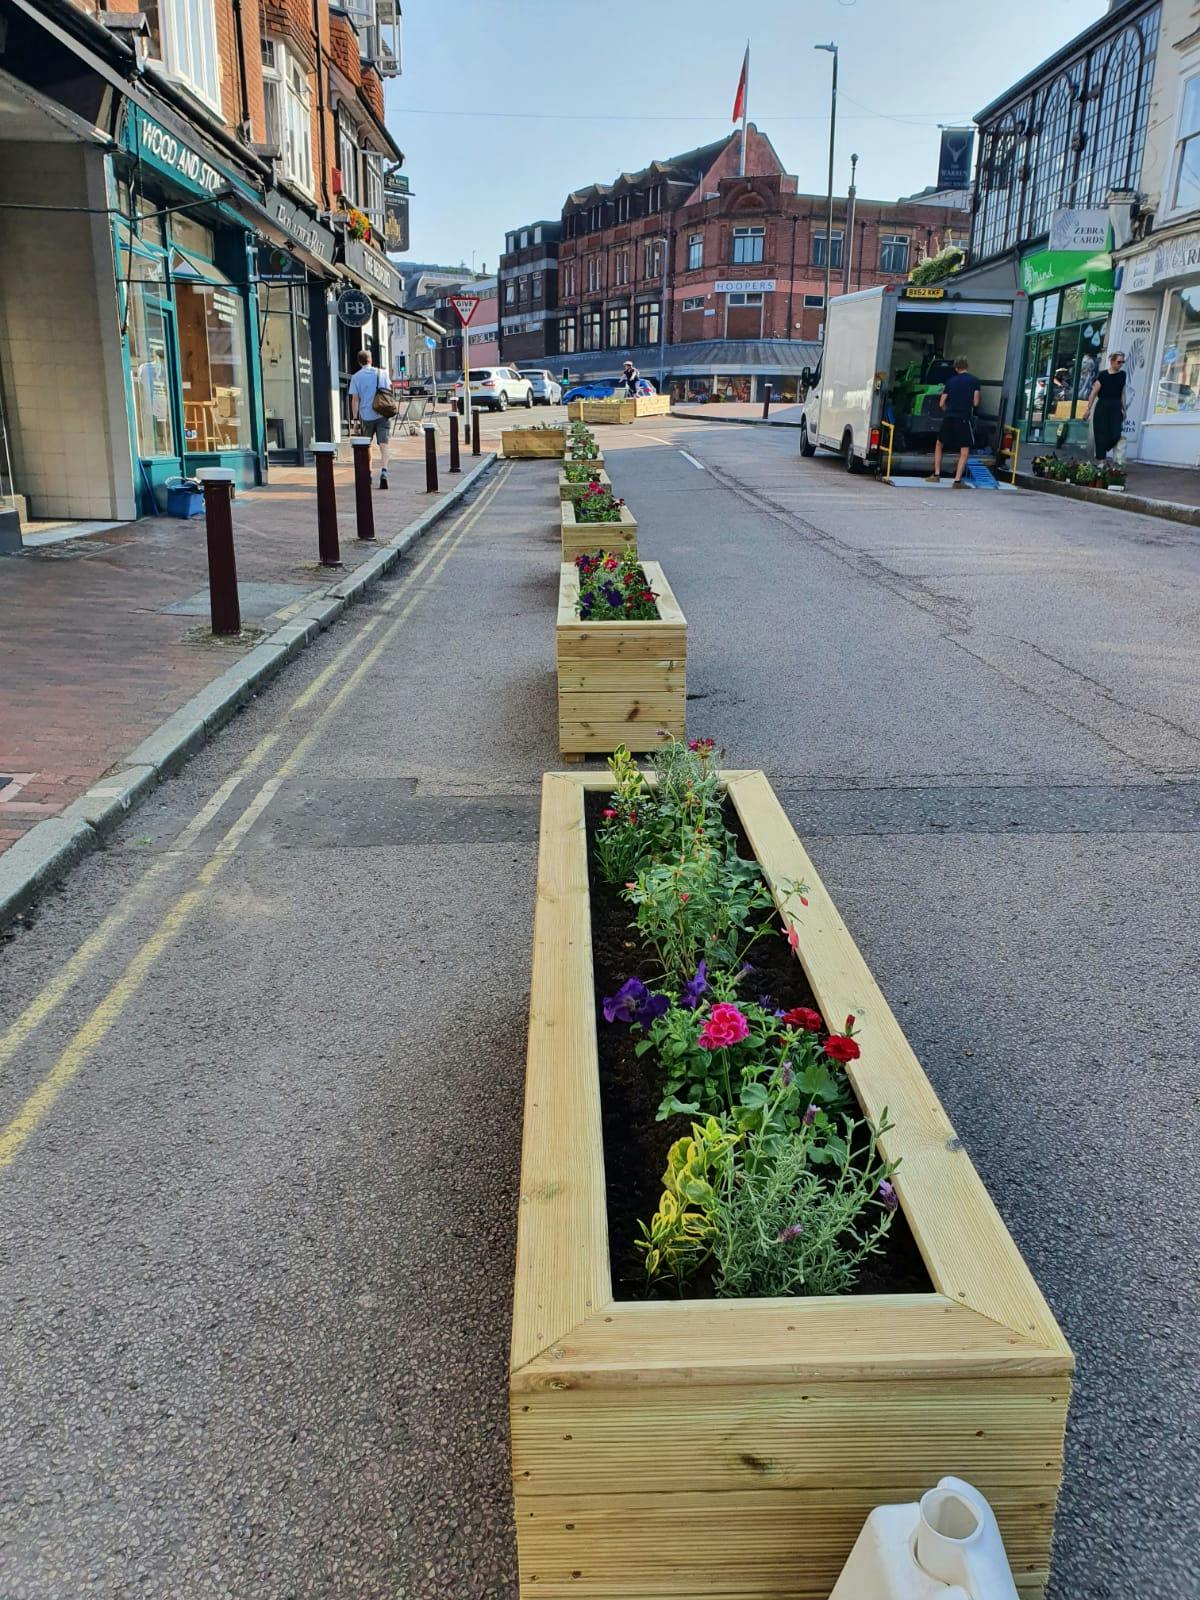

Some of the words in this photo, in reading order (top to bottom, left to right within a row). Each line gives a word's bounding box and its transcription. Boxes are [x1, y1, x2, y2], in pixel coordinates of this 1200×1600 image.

[142, 118, 177, 165] WOOD
[177, 148, 200, 180] AND
[1074, 226, 1105, 235] ZEBRA
[1073, 236, 1105, 244] CARDS
[716, 281, 774, 291] HOOPERS
